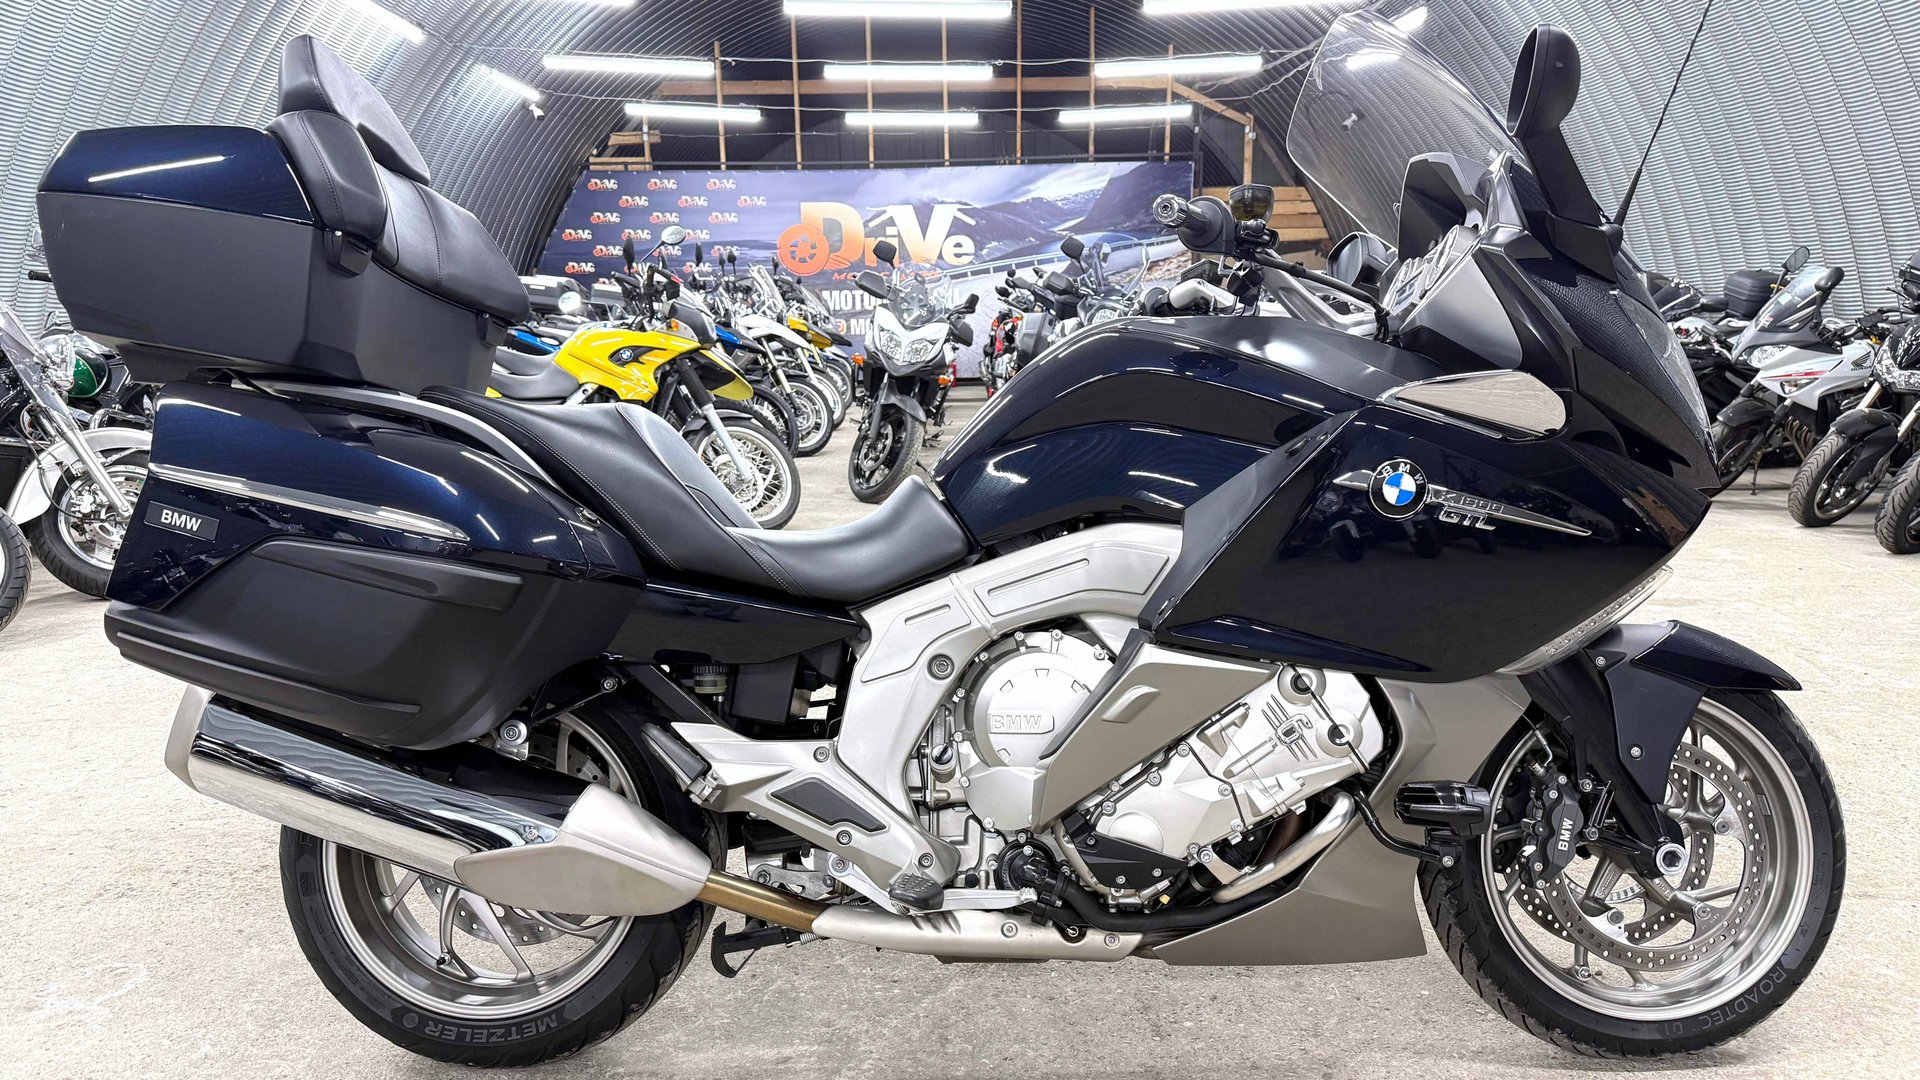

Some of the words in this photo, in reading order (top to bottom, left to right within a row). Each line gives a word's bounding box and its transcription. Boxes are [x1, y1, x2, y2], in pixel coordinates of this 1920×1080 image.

[1381, 462, 1425, 485] BMW
[161, 509, 202, 532] BMW
[1438, 505, 1497, 531] GTL
[991, 714, 1042, 731] BMW
[1557, 817, 1574, 851] BMW
[1699, 965, 1788, 1030] ROADTEC
[424, 1013, 558, 1043] METZELER
